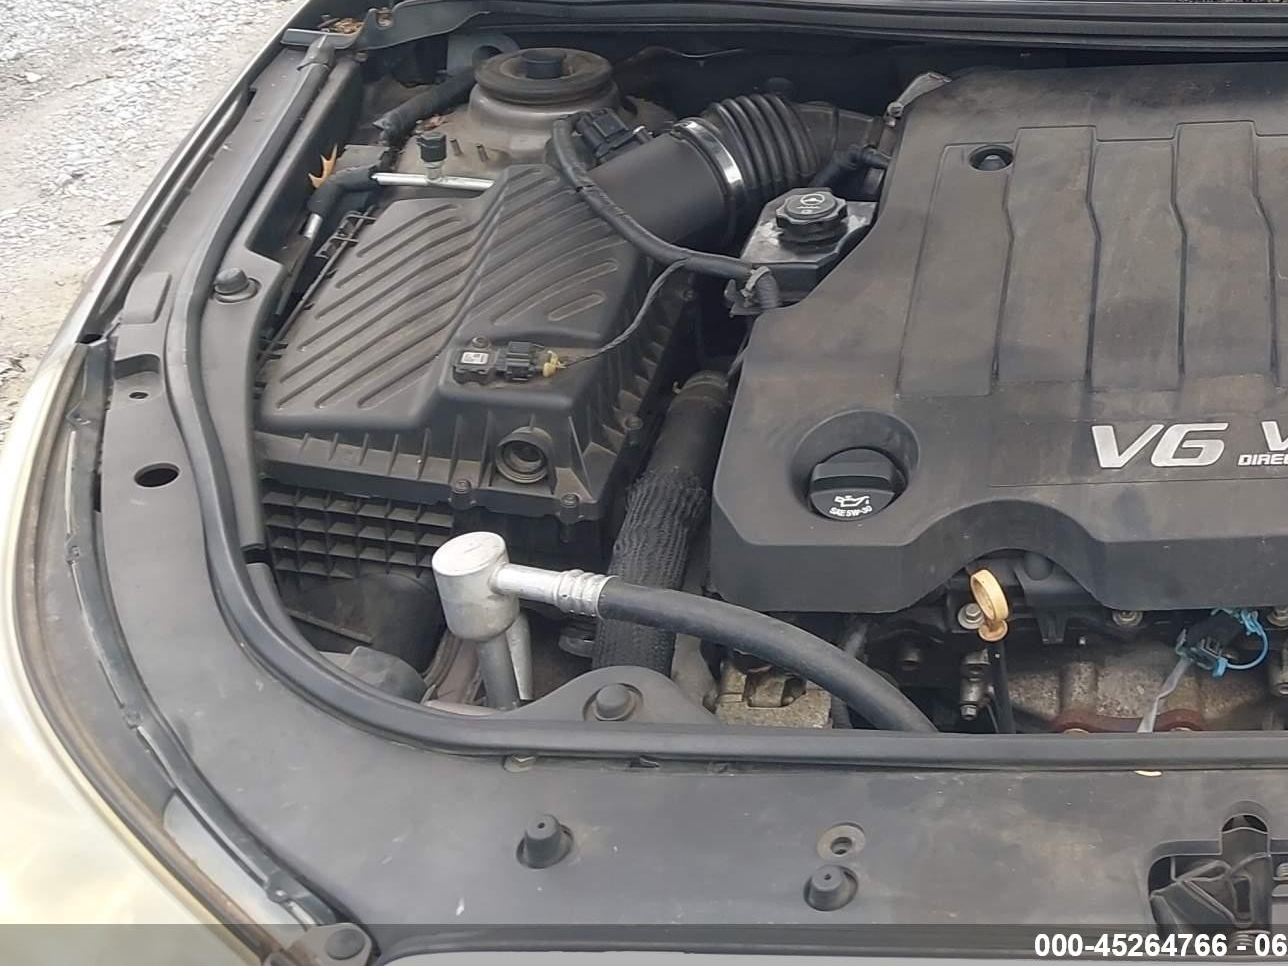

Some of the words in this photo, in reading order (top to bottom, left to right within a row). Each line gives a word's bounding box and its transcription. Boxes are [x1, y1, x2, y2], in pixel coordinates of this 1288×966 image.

[1091, 422, 1230, 468] V6
[829, 507, 846, 517] SAE
[846, 505, 873, 517] 5W-30
